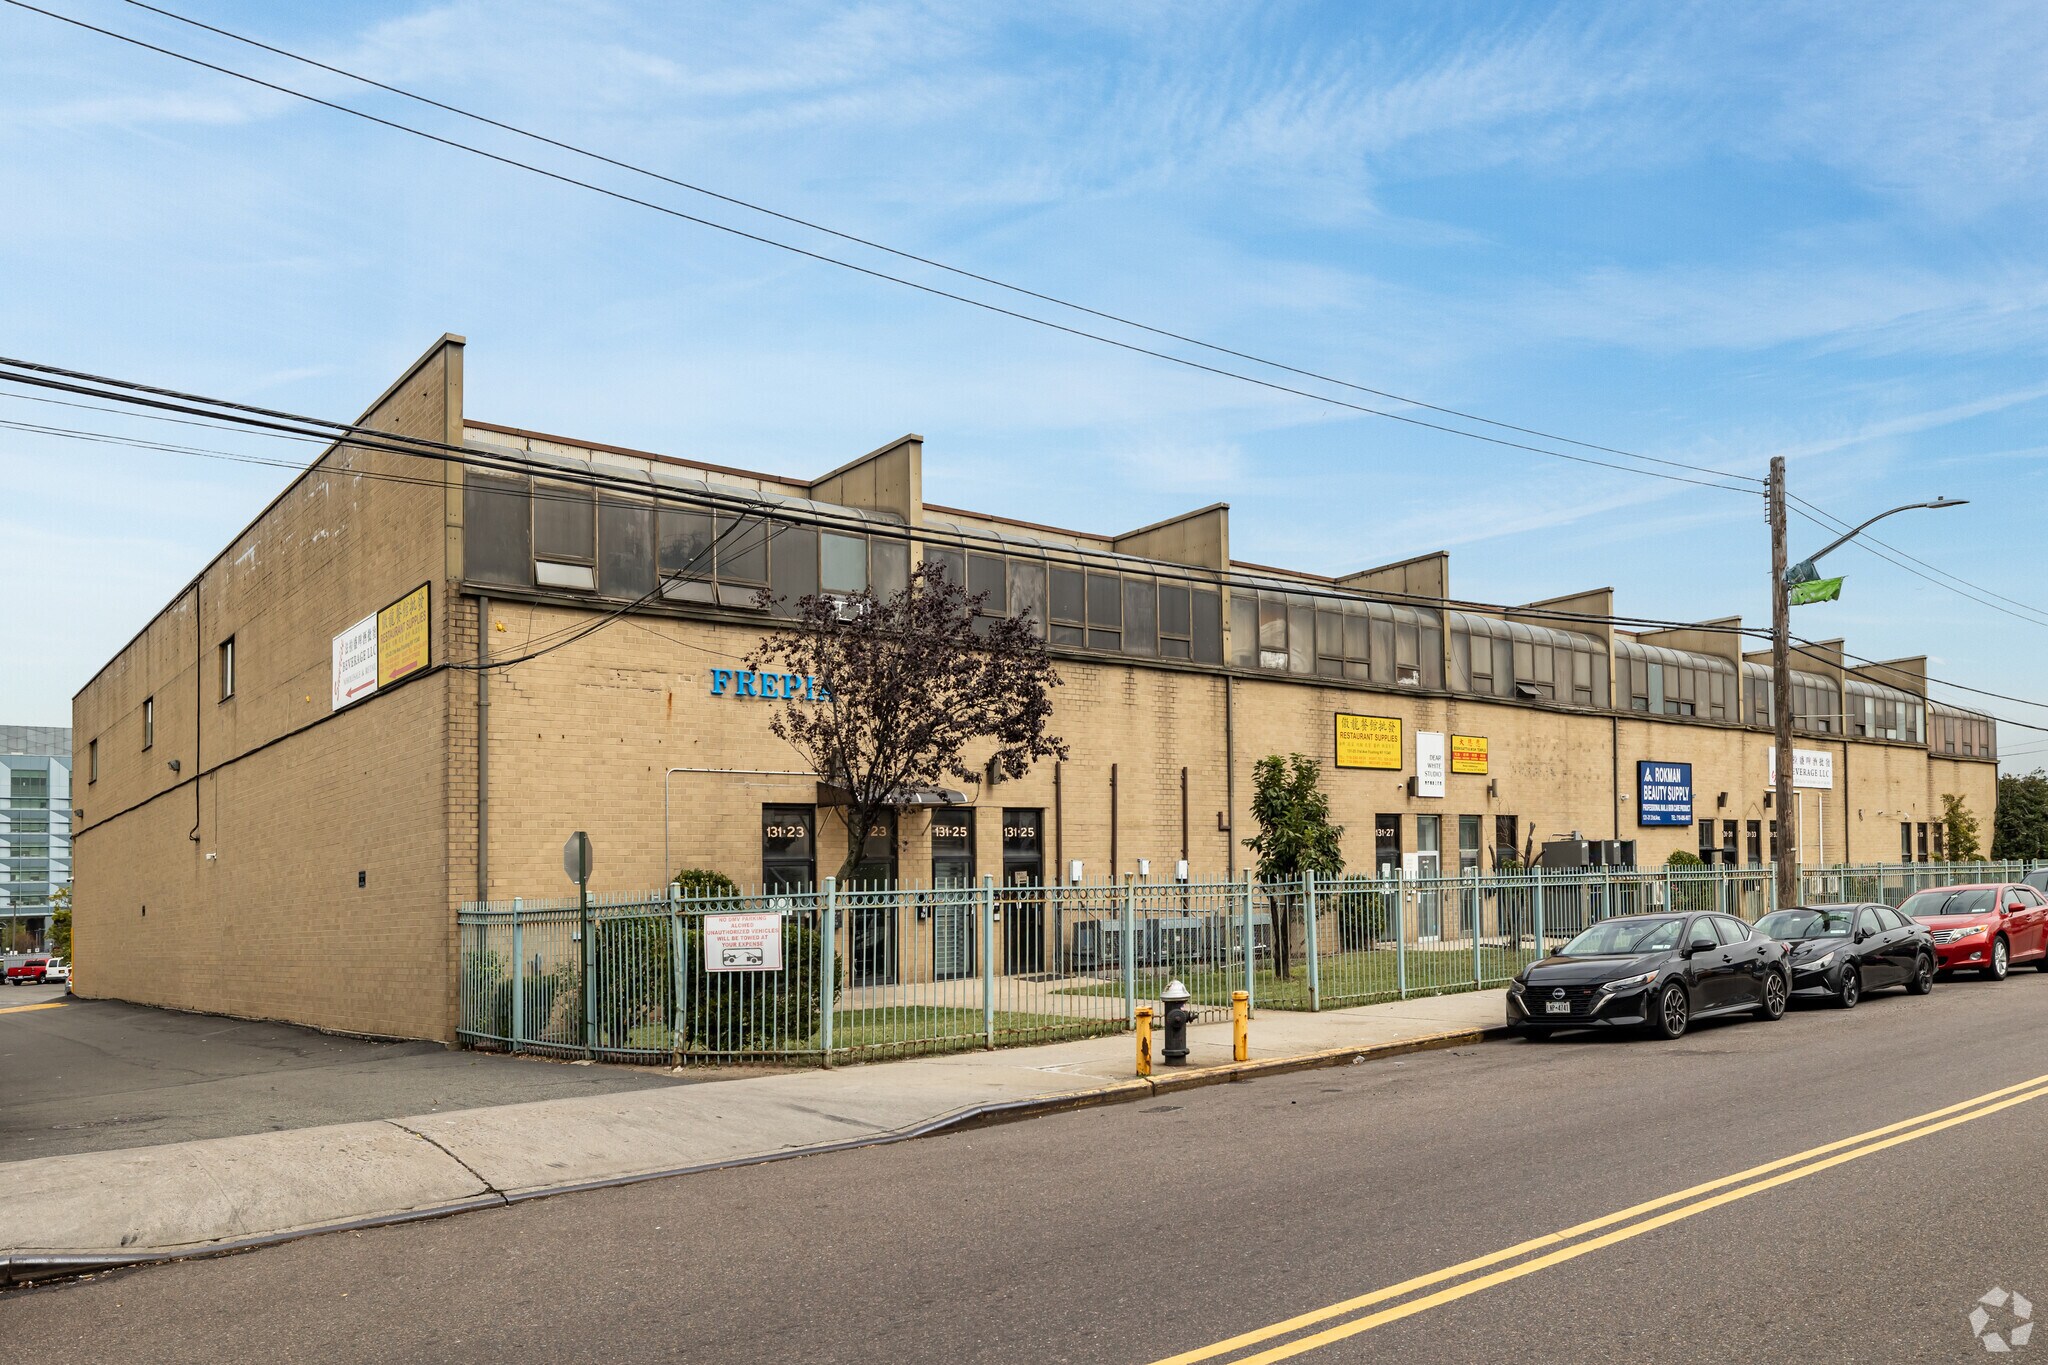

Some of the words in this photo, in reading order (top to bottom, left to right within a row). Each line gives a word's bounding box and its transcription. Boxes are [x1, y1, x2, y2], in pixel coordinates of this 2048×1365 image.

[380, 621, 406, 644] RESTAURANT
[406, 610, 426, 628] SUPPLIES
[342, 650, 366, 672] BEVERAGE
[367, 644, 376, 659] LLC
[1340, 732, 1373, 741] RESTAURANT
[1375, 734, 1398, 742] SUPPLIES
[1655, 767, 1681, 783] ROKMAN
[1793, 768, 1818, 777] EVERAGE
[1643, 785, 1667, 800] BEAUTY
[1667, 786, 1689, 801] SUPPLY
